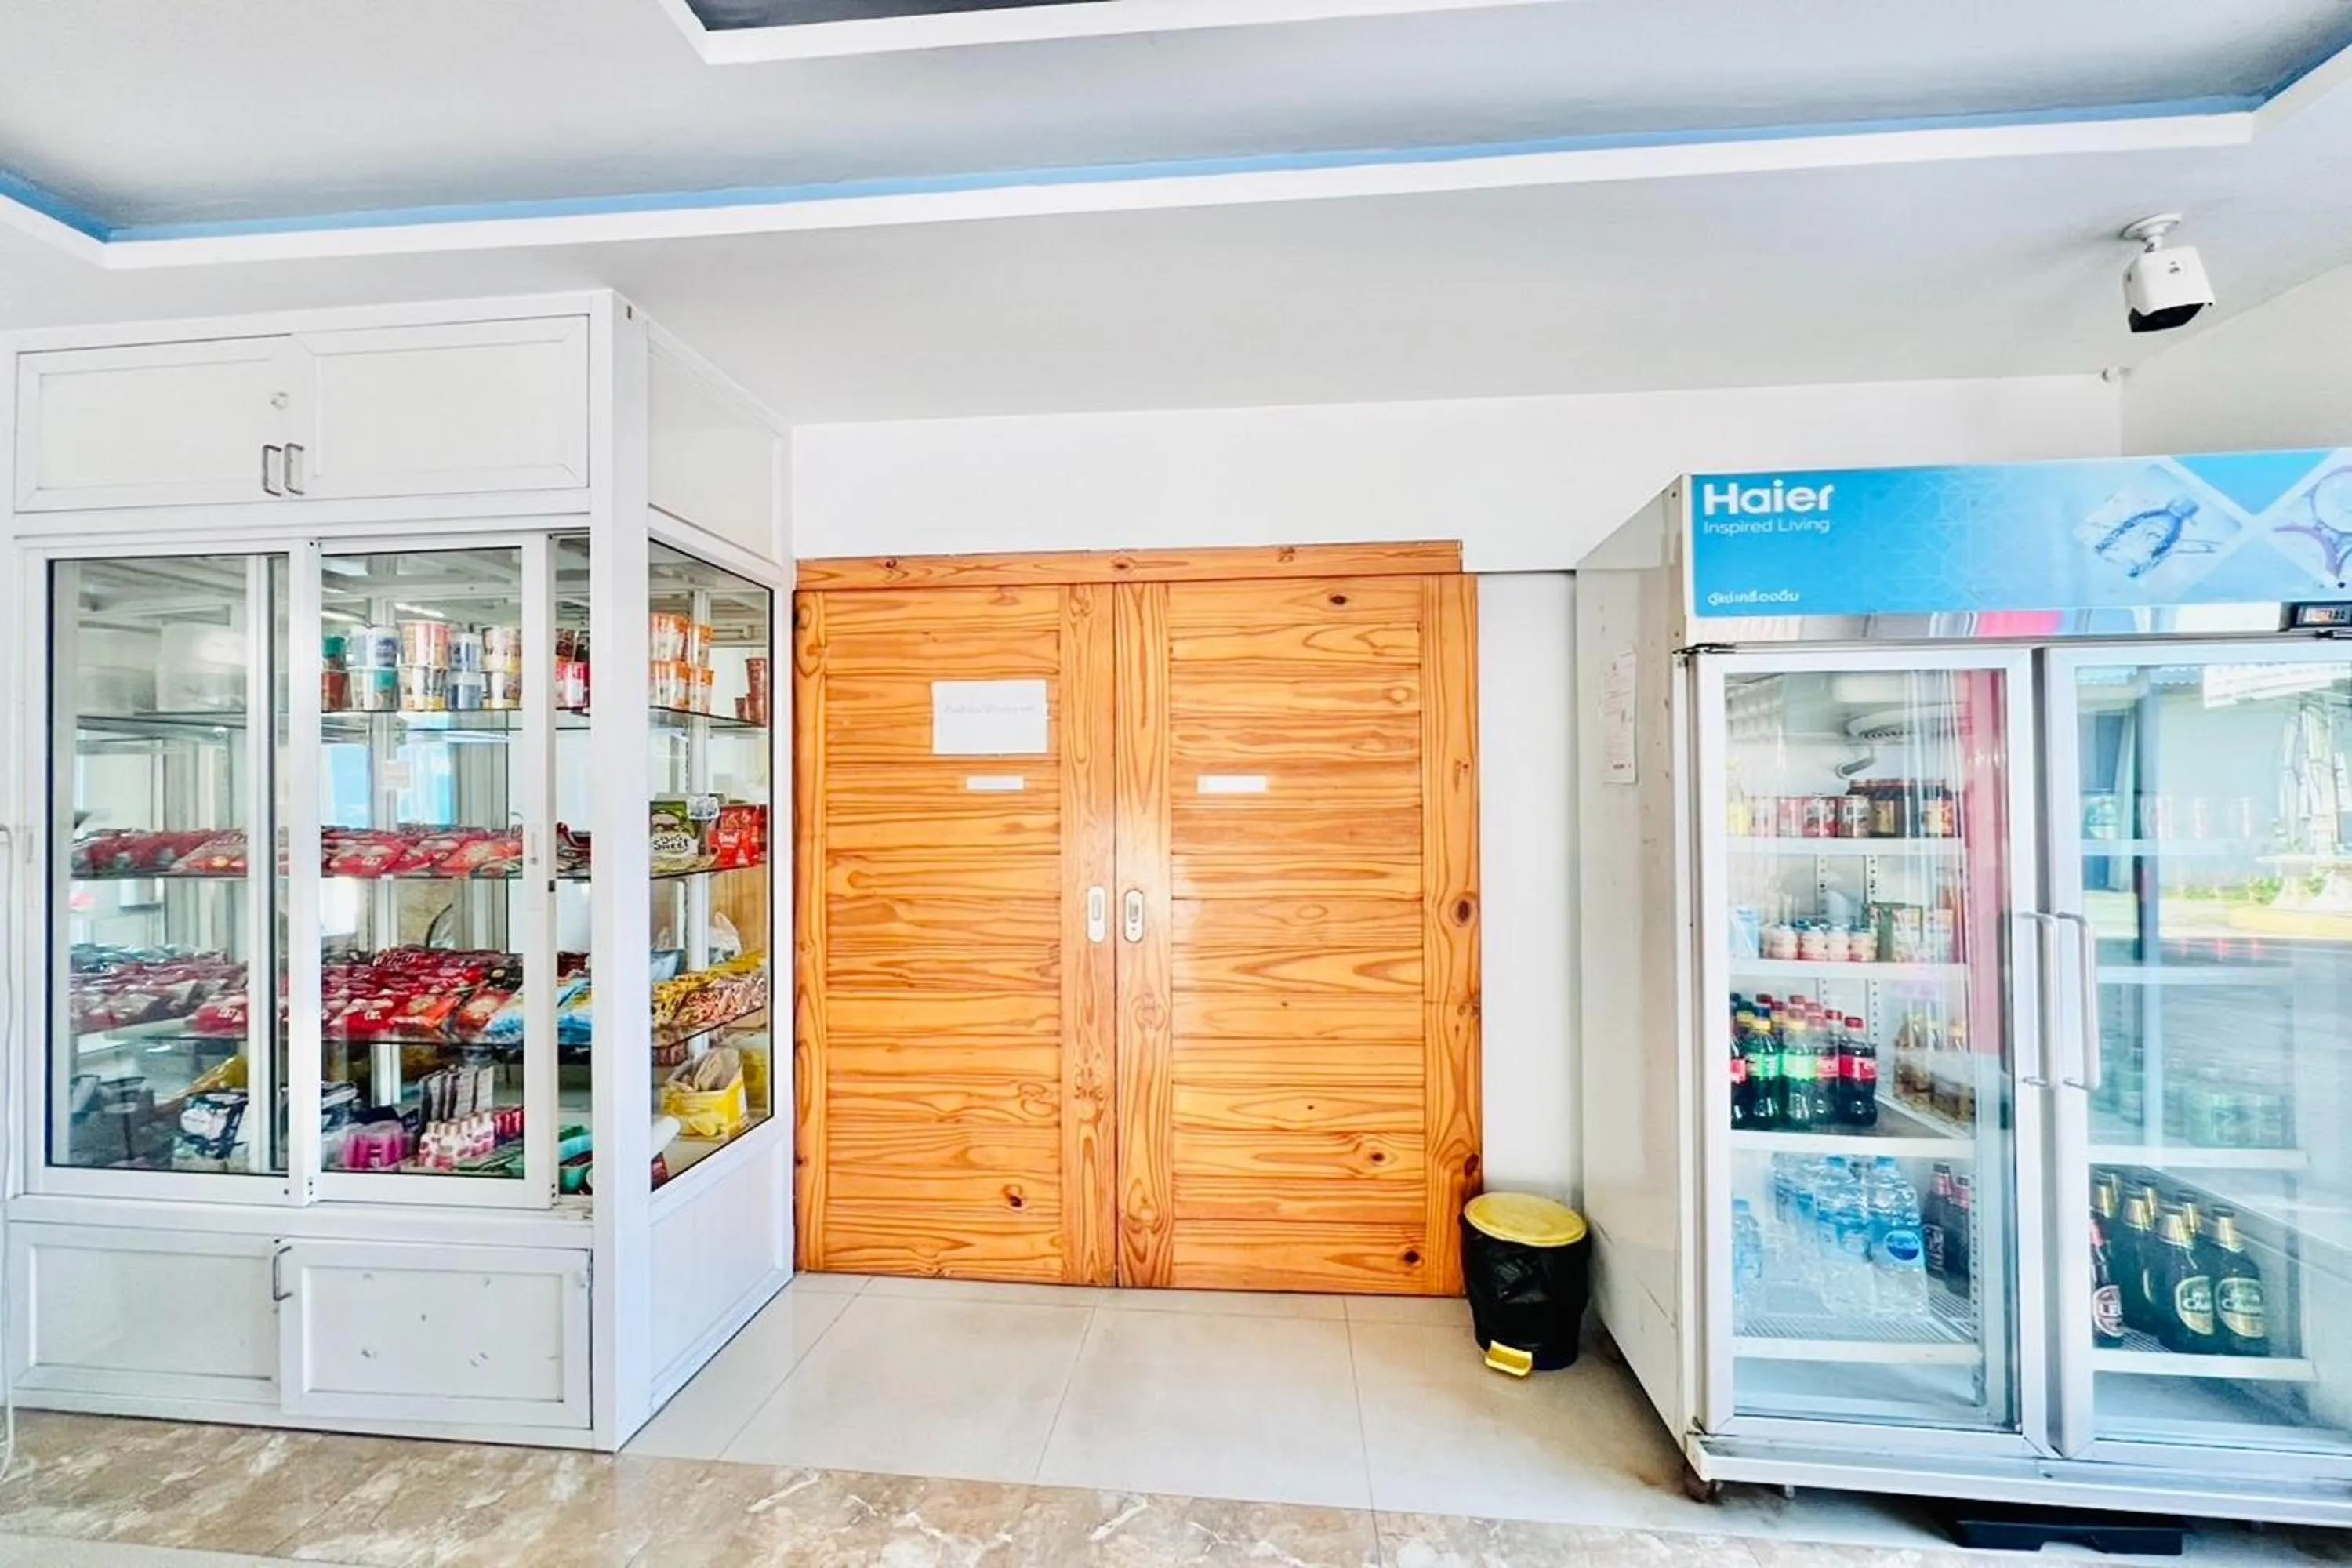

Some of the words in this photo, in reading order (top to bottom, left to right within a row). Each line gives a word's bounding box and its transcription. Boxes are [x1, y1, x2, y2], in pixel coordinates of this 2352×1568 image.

[1704, 479, 1835, 515] Haier
[1704, 520, 1773, 536] Inspired
[1777, 517, 1830, 533] Living
